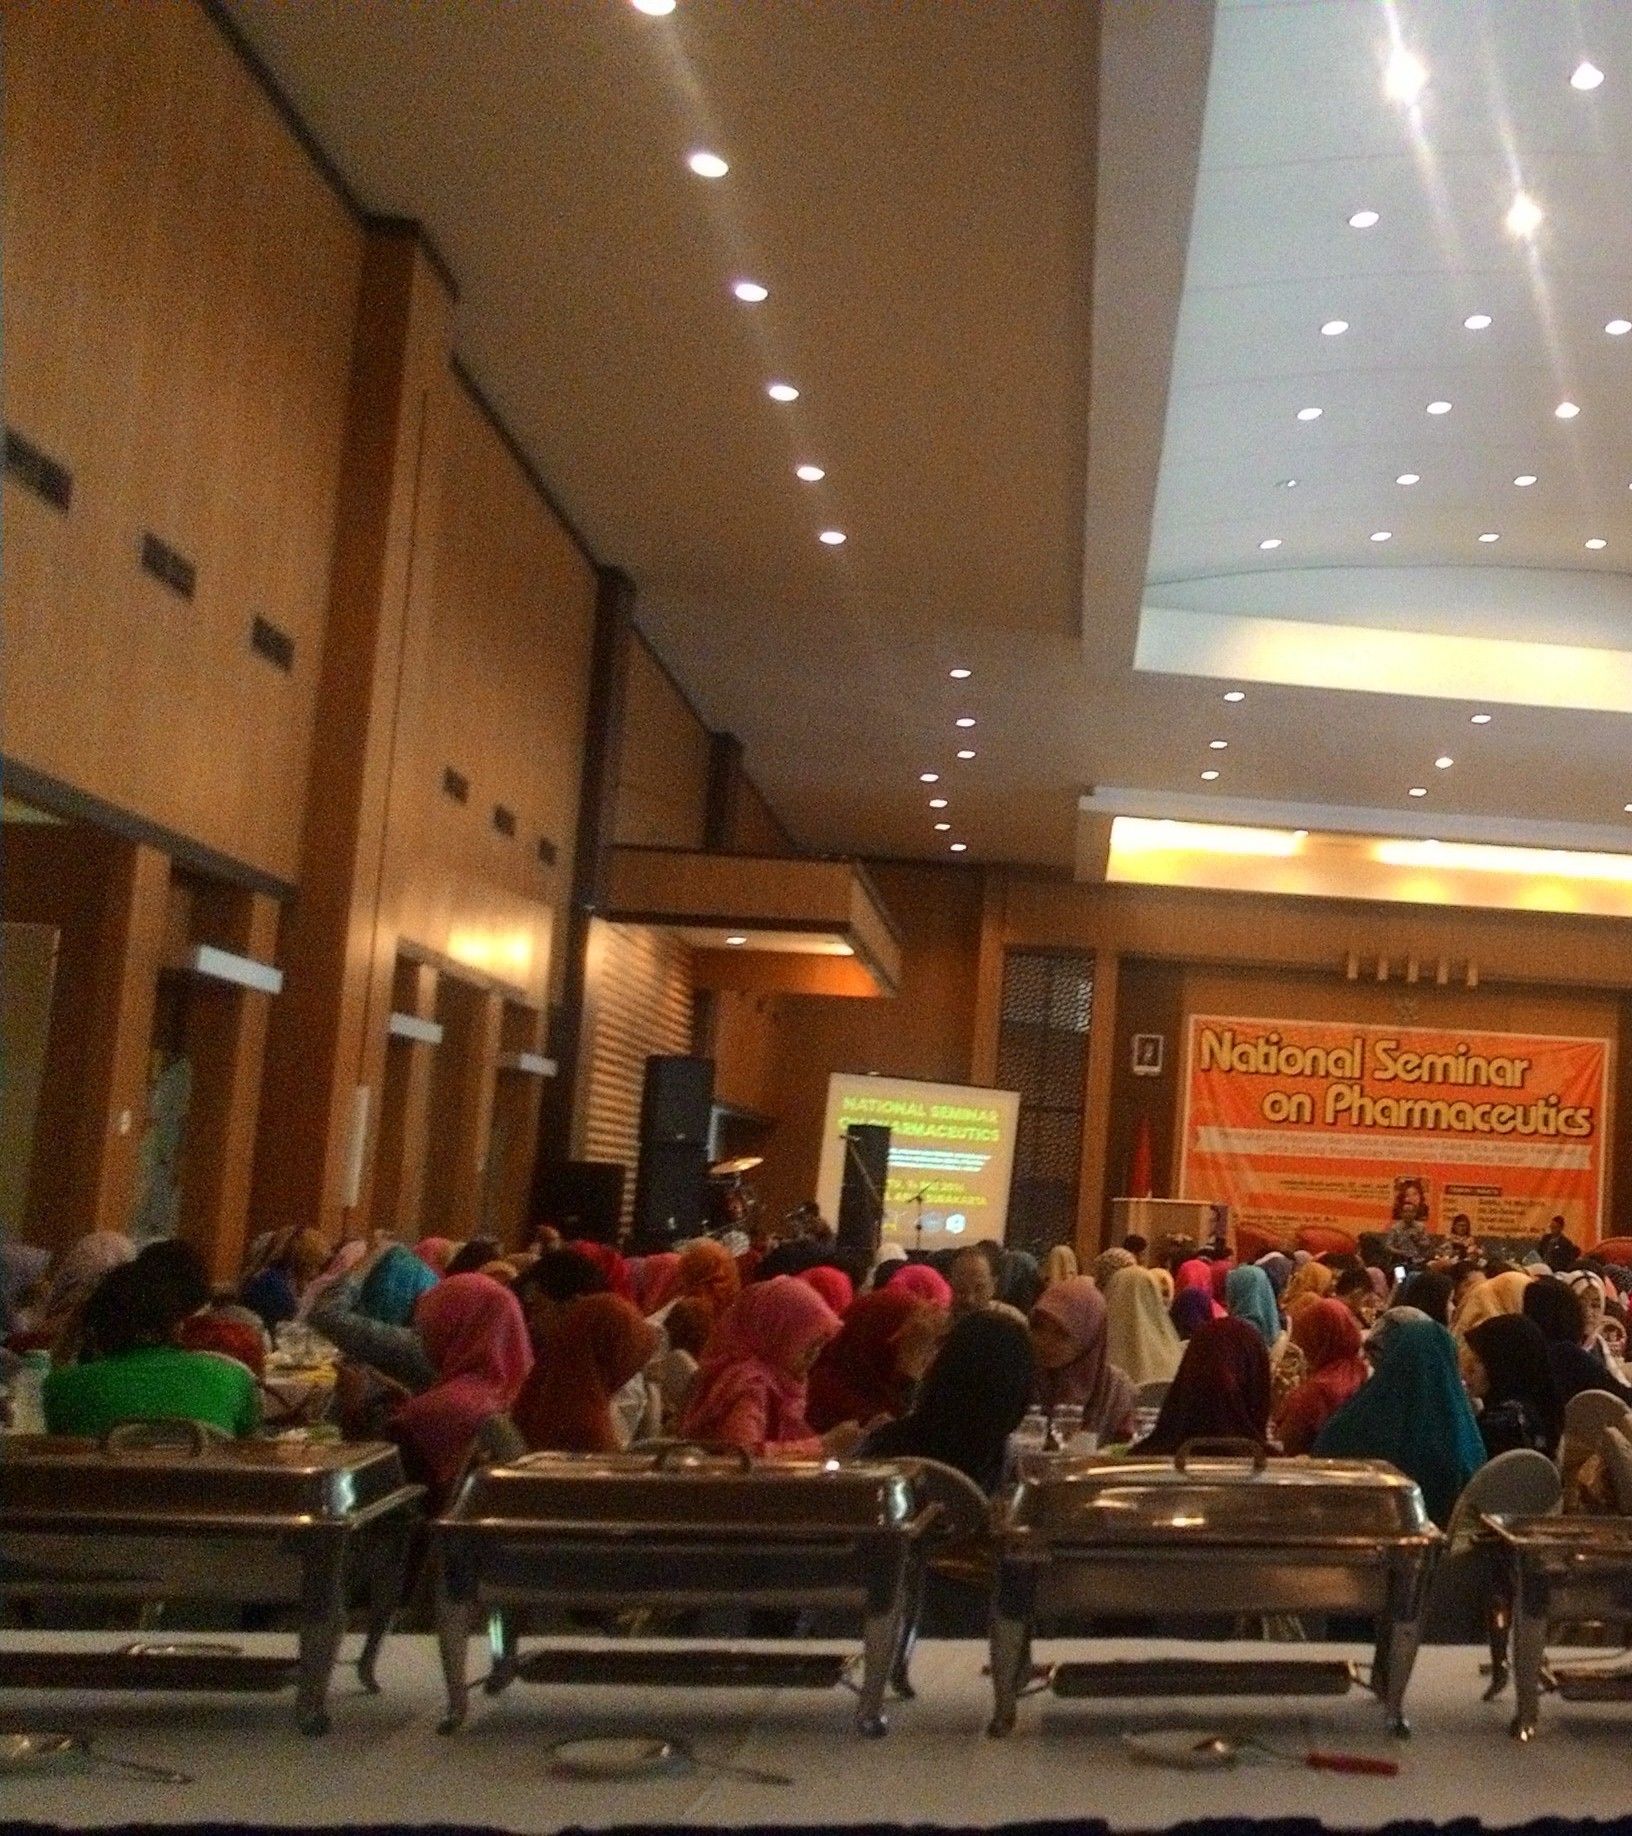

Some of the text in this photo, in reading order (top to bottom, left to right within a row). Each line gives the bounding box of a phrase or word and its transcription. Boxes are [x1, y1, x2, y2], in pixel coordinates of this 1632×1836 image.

[1200, 1027, 1532, 1089] National Seminar
[845, 1098, 999, 1122] NATIONAL SEMINAR
[1262, 1082, 1594, 1138] on Pharmaceutics
